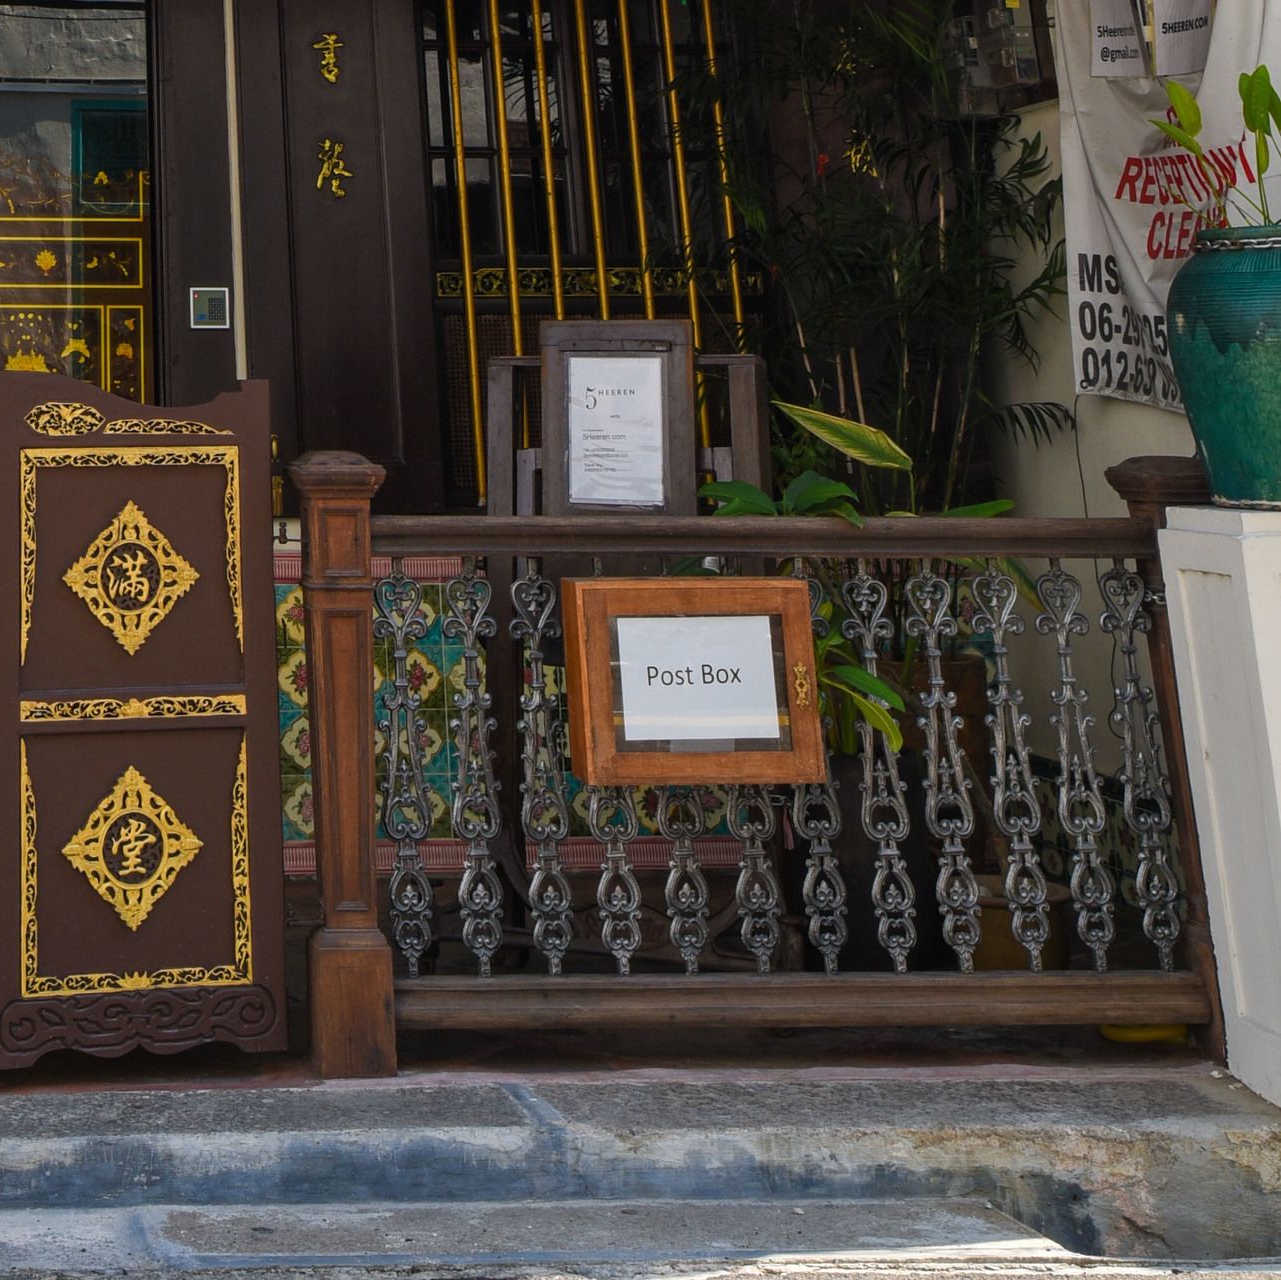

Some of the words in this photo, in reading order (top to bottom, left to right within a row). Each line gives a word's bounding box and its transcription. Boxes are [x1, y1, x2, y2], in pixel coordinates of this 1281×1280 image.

[585, 386, 598, 410] 5
[646, 665, 695, 687] Post
[701, 663, 742, 685] Box
[111, 818, 158, 876] 堂
